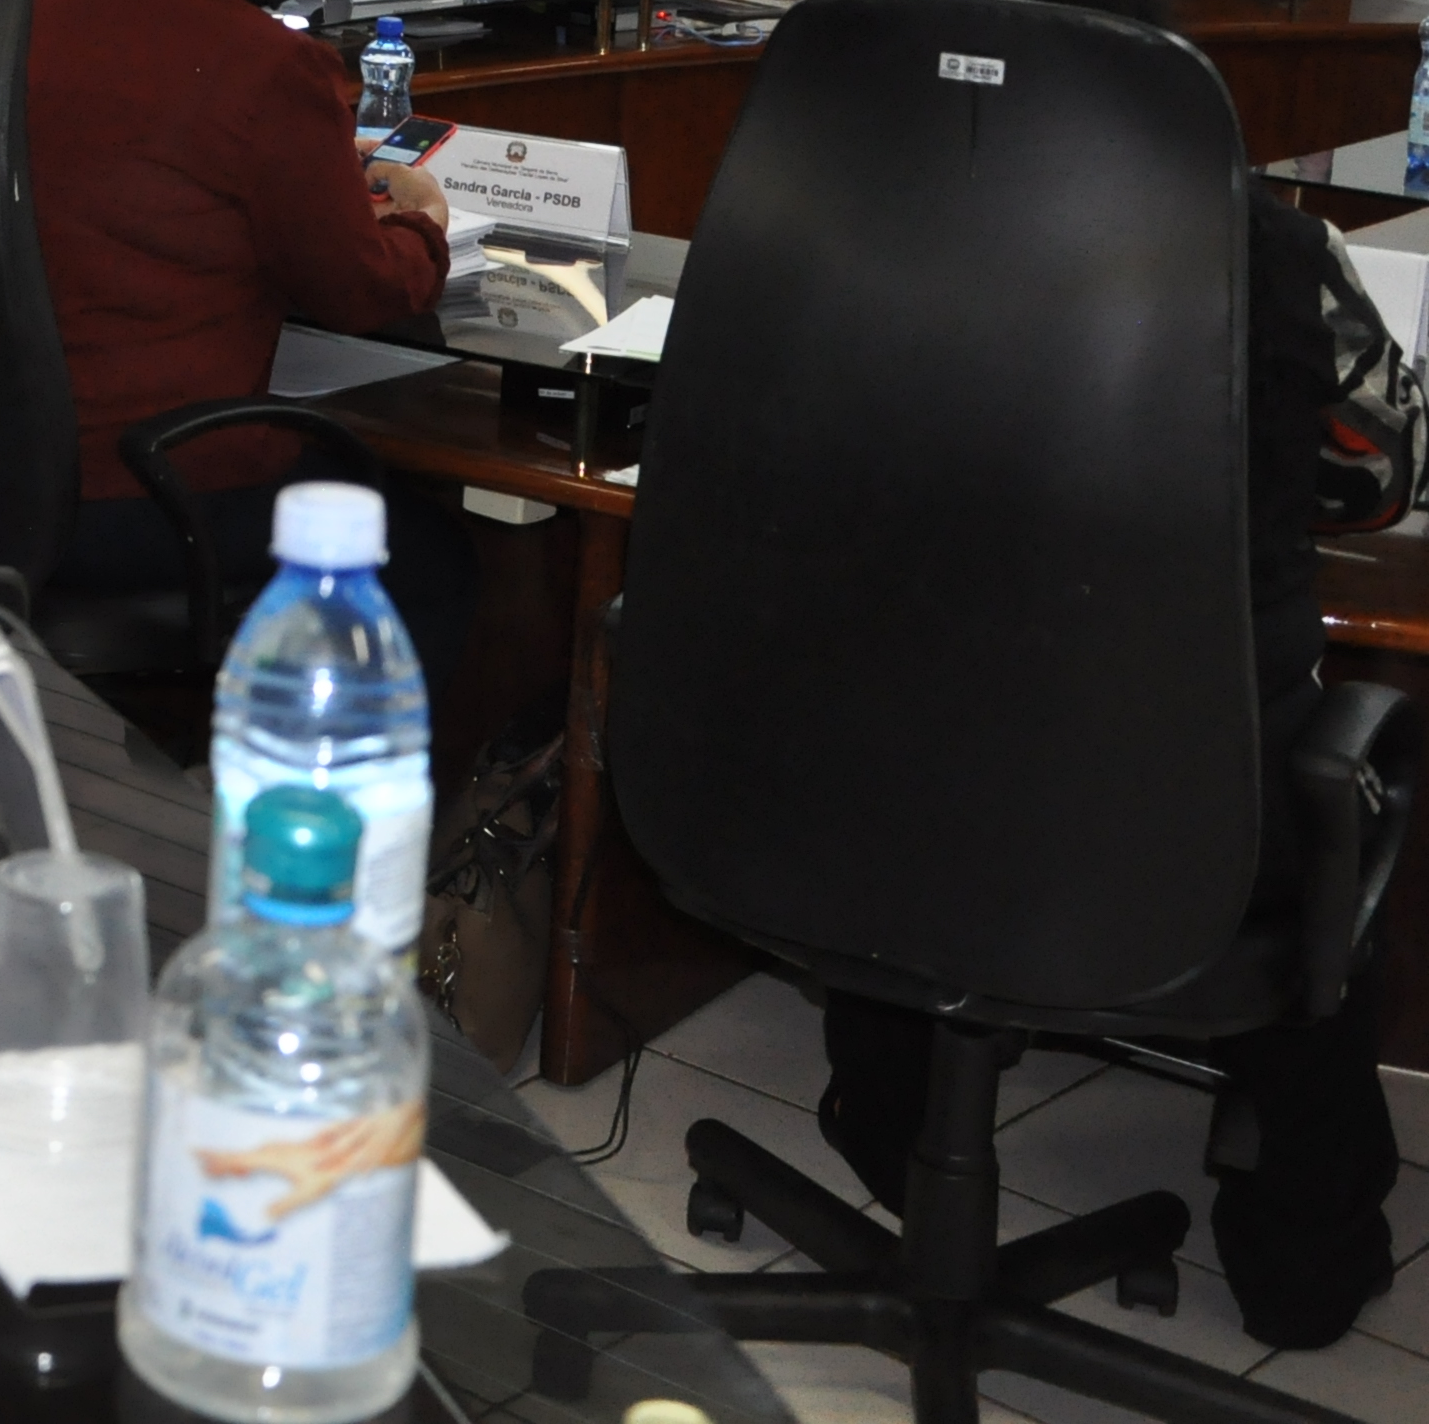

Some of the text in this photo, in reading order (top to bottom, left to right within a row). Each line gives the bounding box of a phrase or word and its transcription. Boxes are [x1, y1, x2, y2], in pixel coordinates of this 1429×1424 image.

[443, 177, 488, 195] Sandra
[491, 184, 532, 201] Garcia
[543, 191, 582, 209] PSDB
[486, 196, 534, 213] Vereadora
